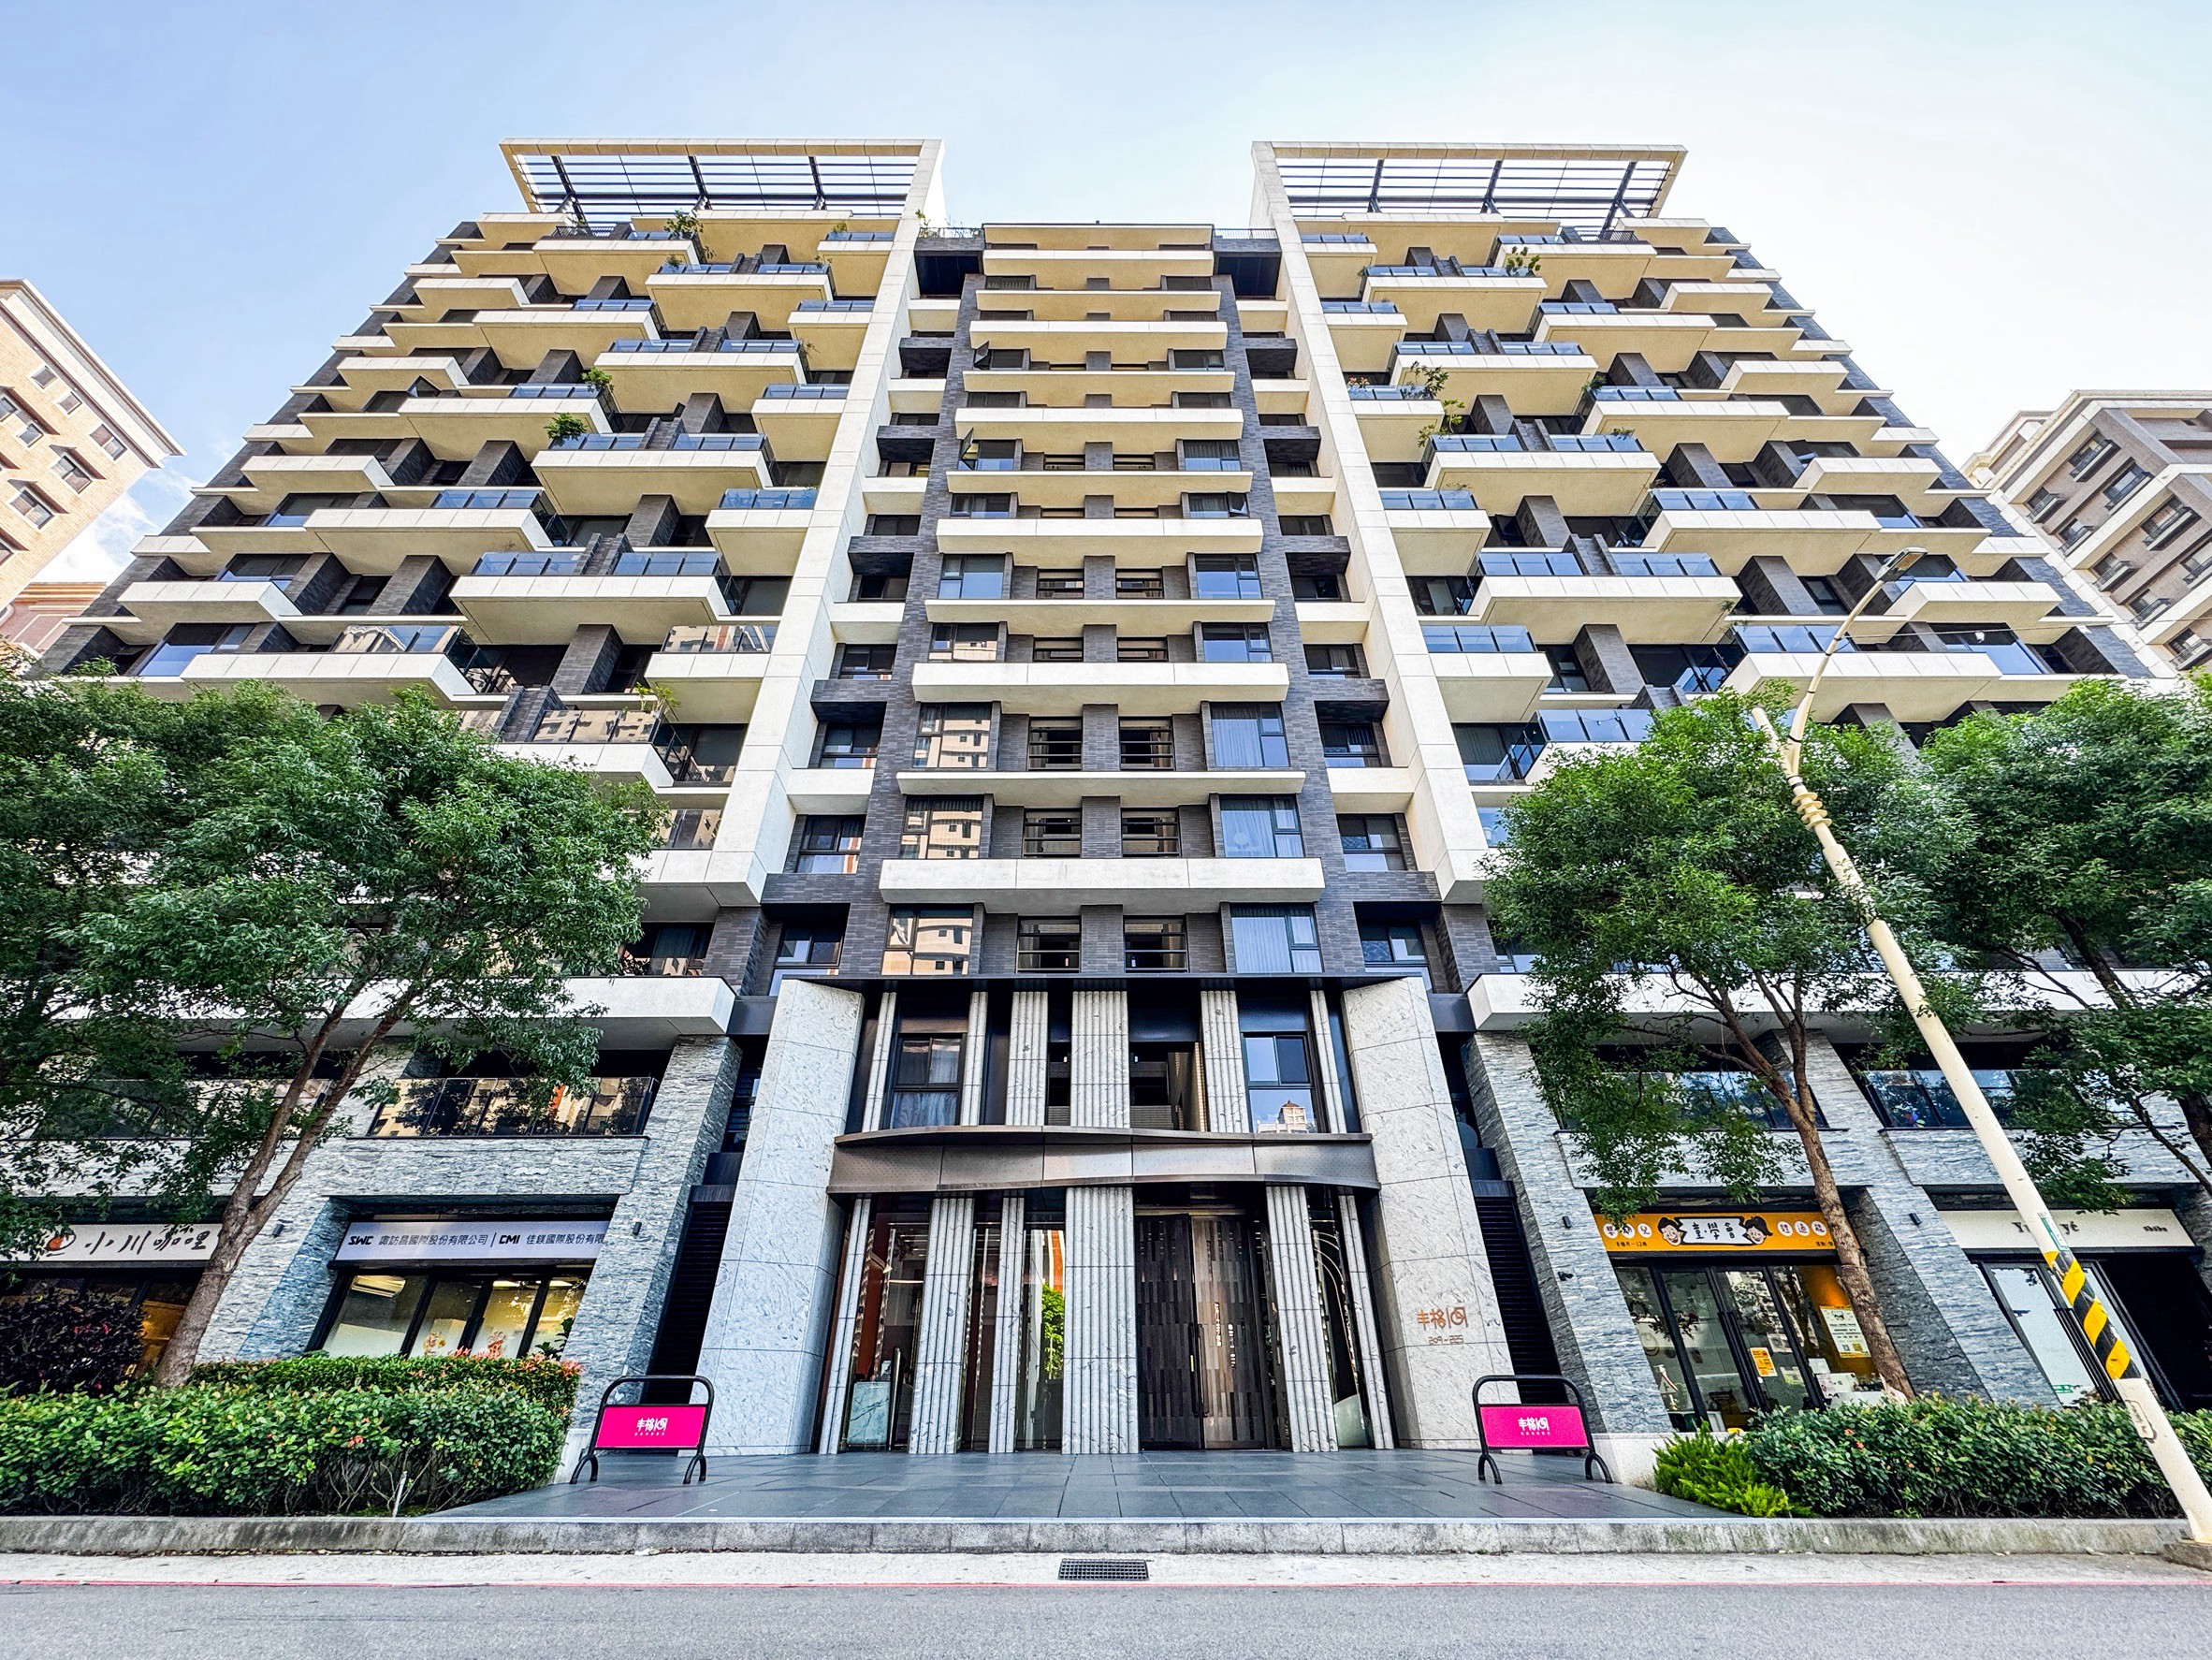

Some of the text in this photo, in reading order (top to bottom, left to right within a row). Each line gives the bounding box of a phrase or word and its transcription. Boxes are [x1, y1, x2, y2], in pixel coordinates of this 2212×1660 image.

[85, 1229, 211, 1256] 小川咖哩
[347, 1235, 374, 1245] SWC
[499, 1234, 521, 1245] CMI
